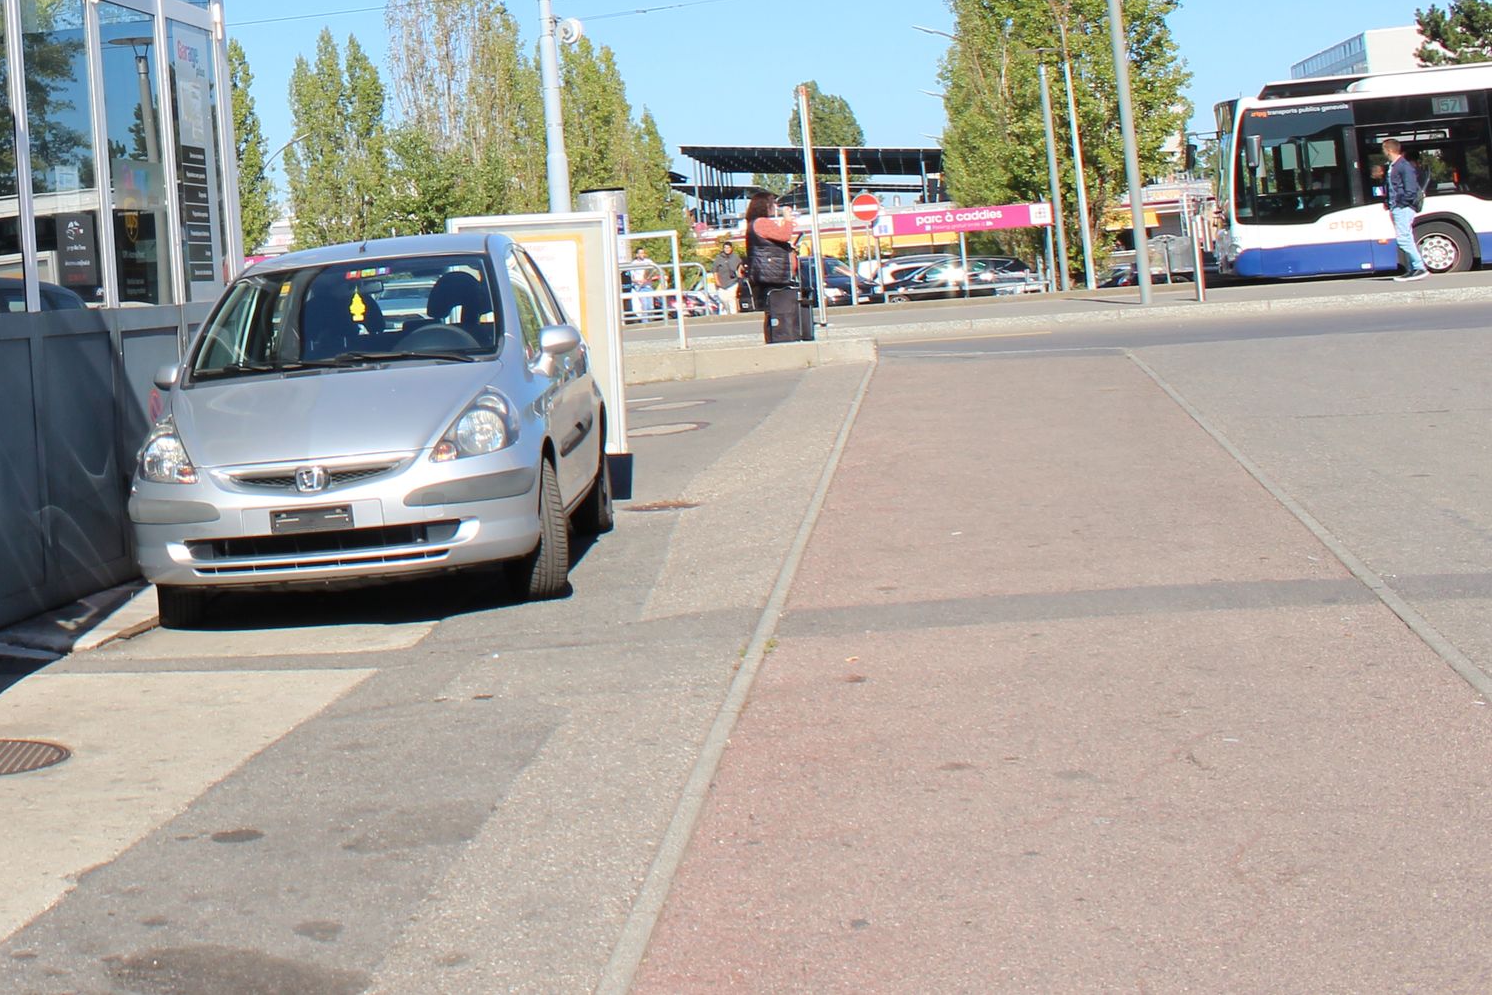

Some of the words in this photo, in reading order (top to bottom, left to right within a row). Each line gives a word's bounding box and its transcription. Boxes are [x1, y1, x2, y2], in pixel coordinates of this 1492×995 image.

[1267, 108, 1297, 116] transports
[1298, 105, 1320, 114] publics
[1321, 103, 1348, 113] genevois
[915, 214, 942, 226] parc
[945, 211, 954, 223] à
[955, 209, 1003, 221] caddies
[1339, 220, 1363, 231] tpg
